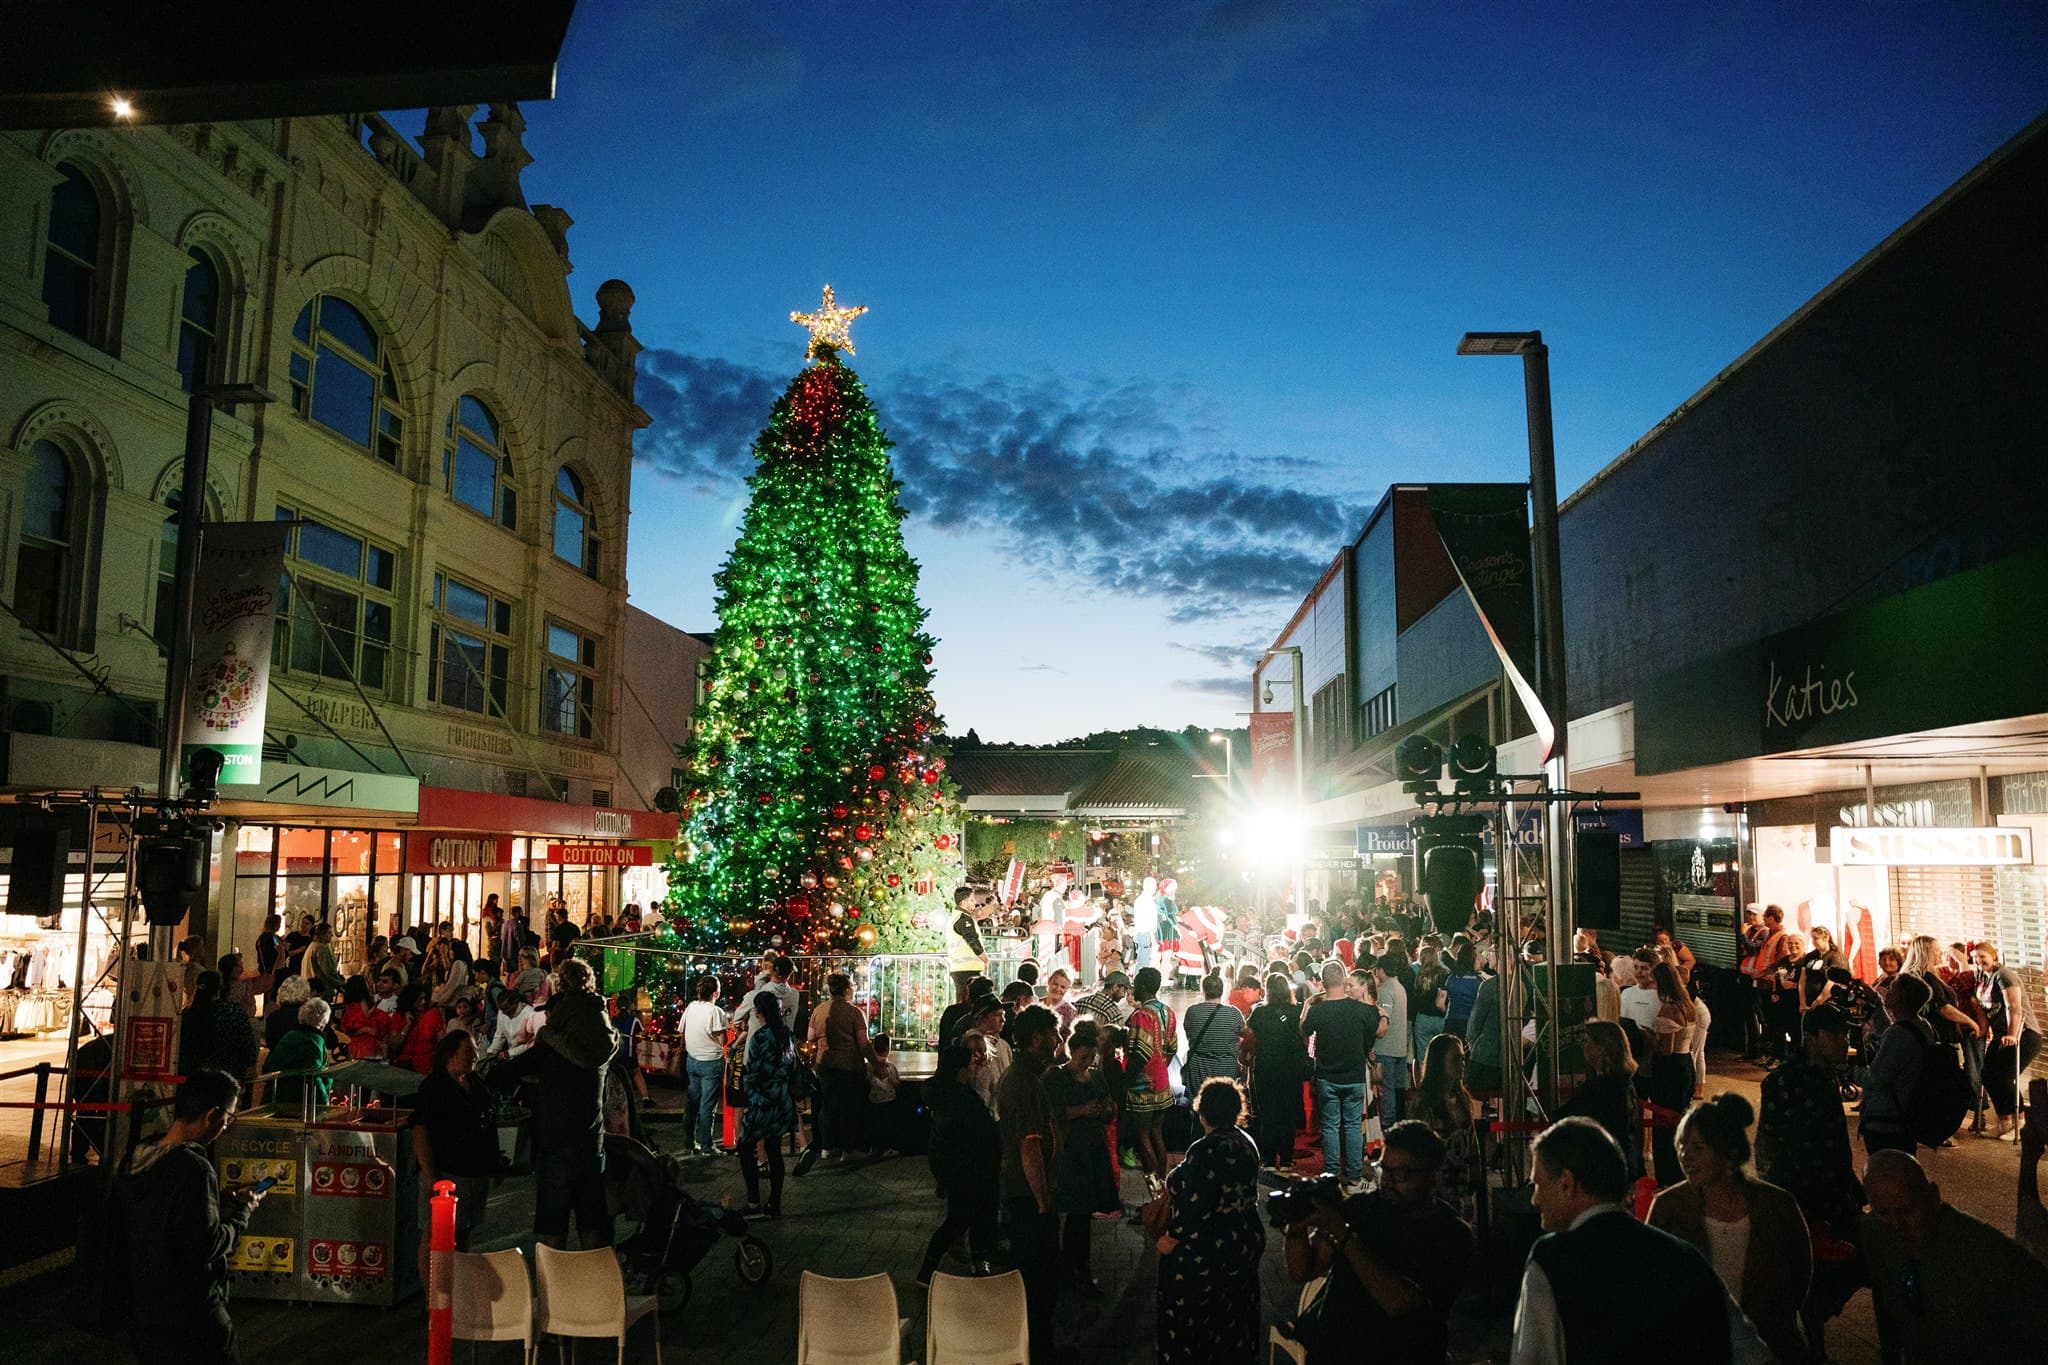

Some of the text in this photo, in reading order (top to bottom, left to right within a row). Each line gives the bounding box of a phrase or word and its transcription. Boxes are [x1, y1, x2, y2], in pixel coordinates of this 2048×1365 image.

[1766, 660, 1858, 728] Katies
[594, 811, 632, 834] COTTON ON
[432, 838, 497, 867] COTTON ON
[562, 847, 635, 864] COTTON ON
[231, 1139, 290, 1153] RECYCLE
[318, 1144, 381, 1158] LANDFILL
